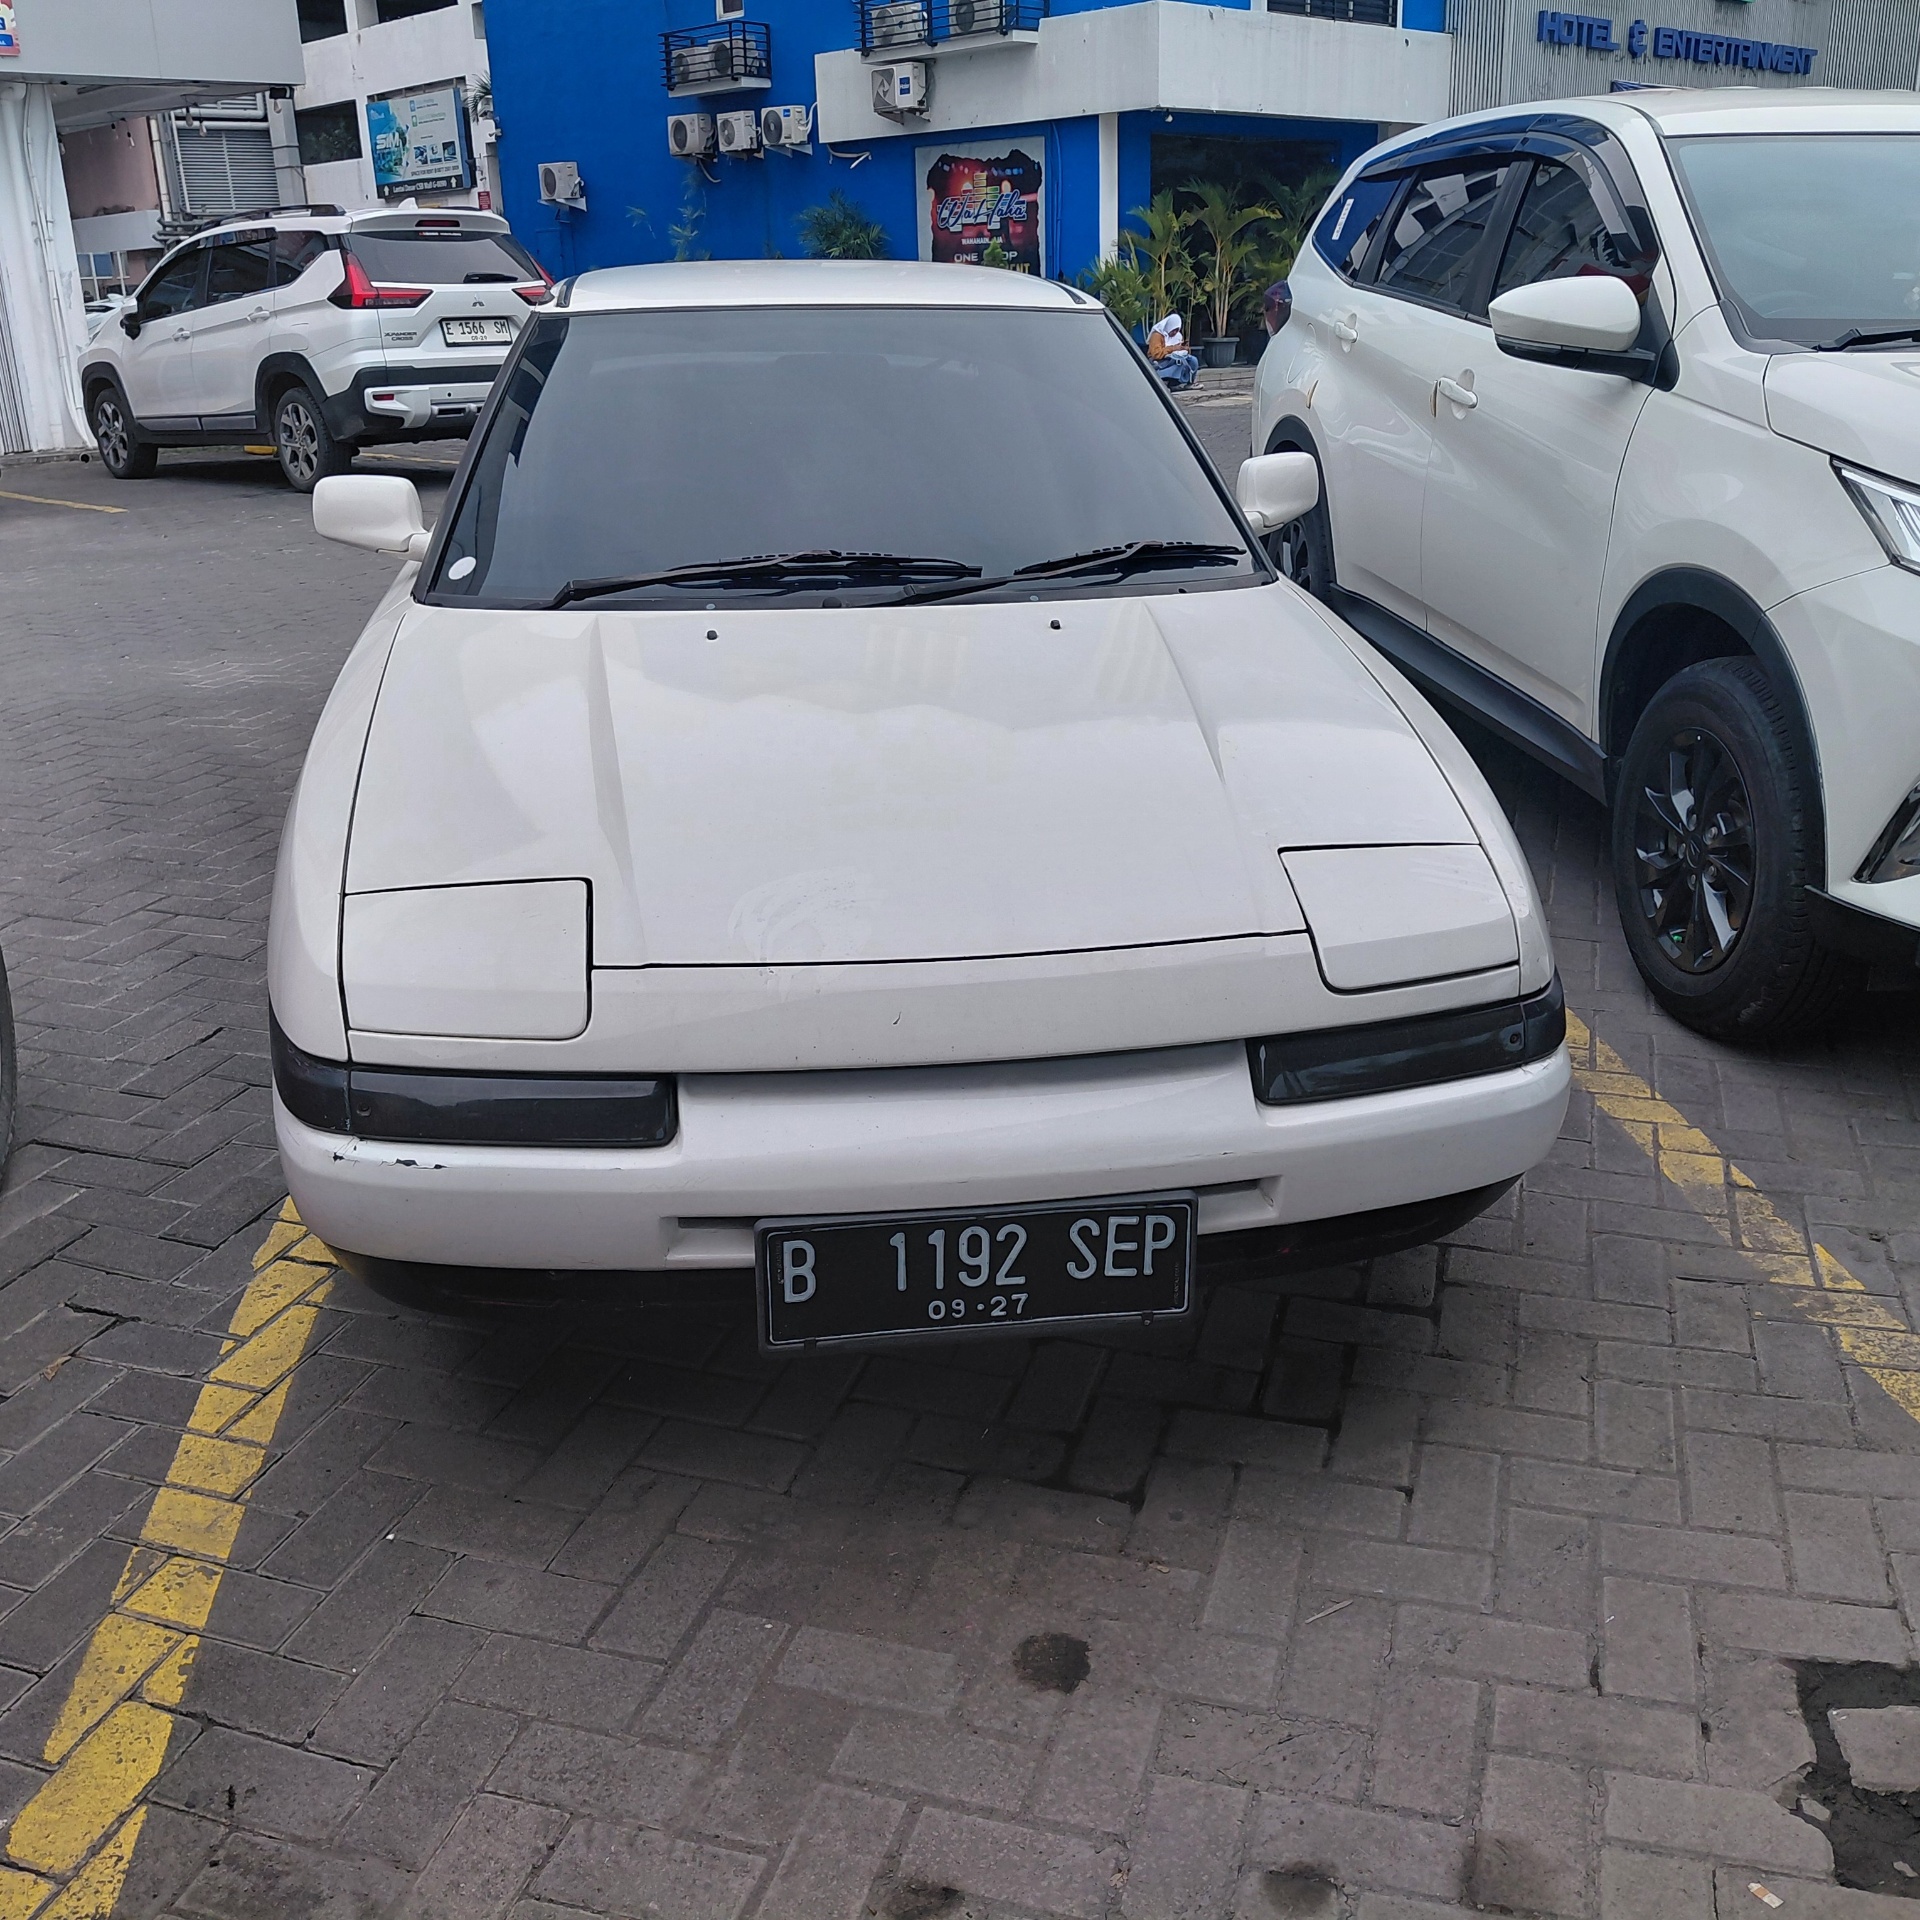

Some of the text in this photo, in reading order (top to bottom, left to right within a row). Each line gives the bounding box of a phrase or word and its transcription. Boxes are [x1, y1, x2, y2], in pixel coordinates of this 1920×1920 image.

[1537, 10, 1818, 75] HOTEL & ENTERTAINMENT
[376, 132, 399, 150] SIM
[954, 252, 978, 262] ONE
[445, 320, 508, 335] E 1566 SM
[783, 1239, 817, 1303] B
[889, 1223, 1028, 1292] 1192
[1066, 1215, 1177, 1280] SEP
